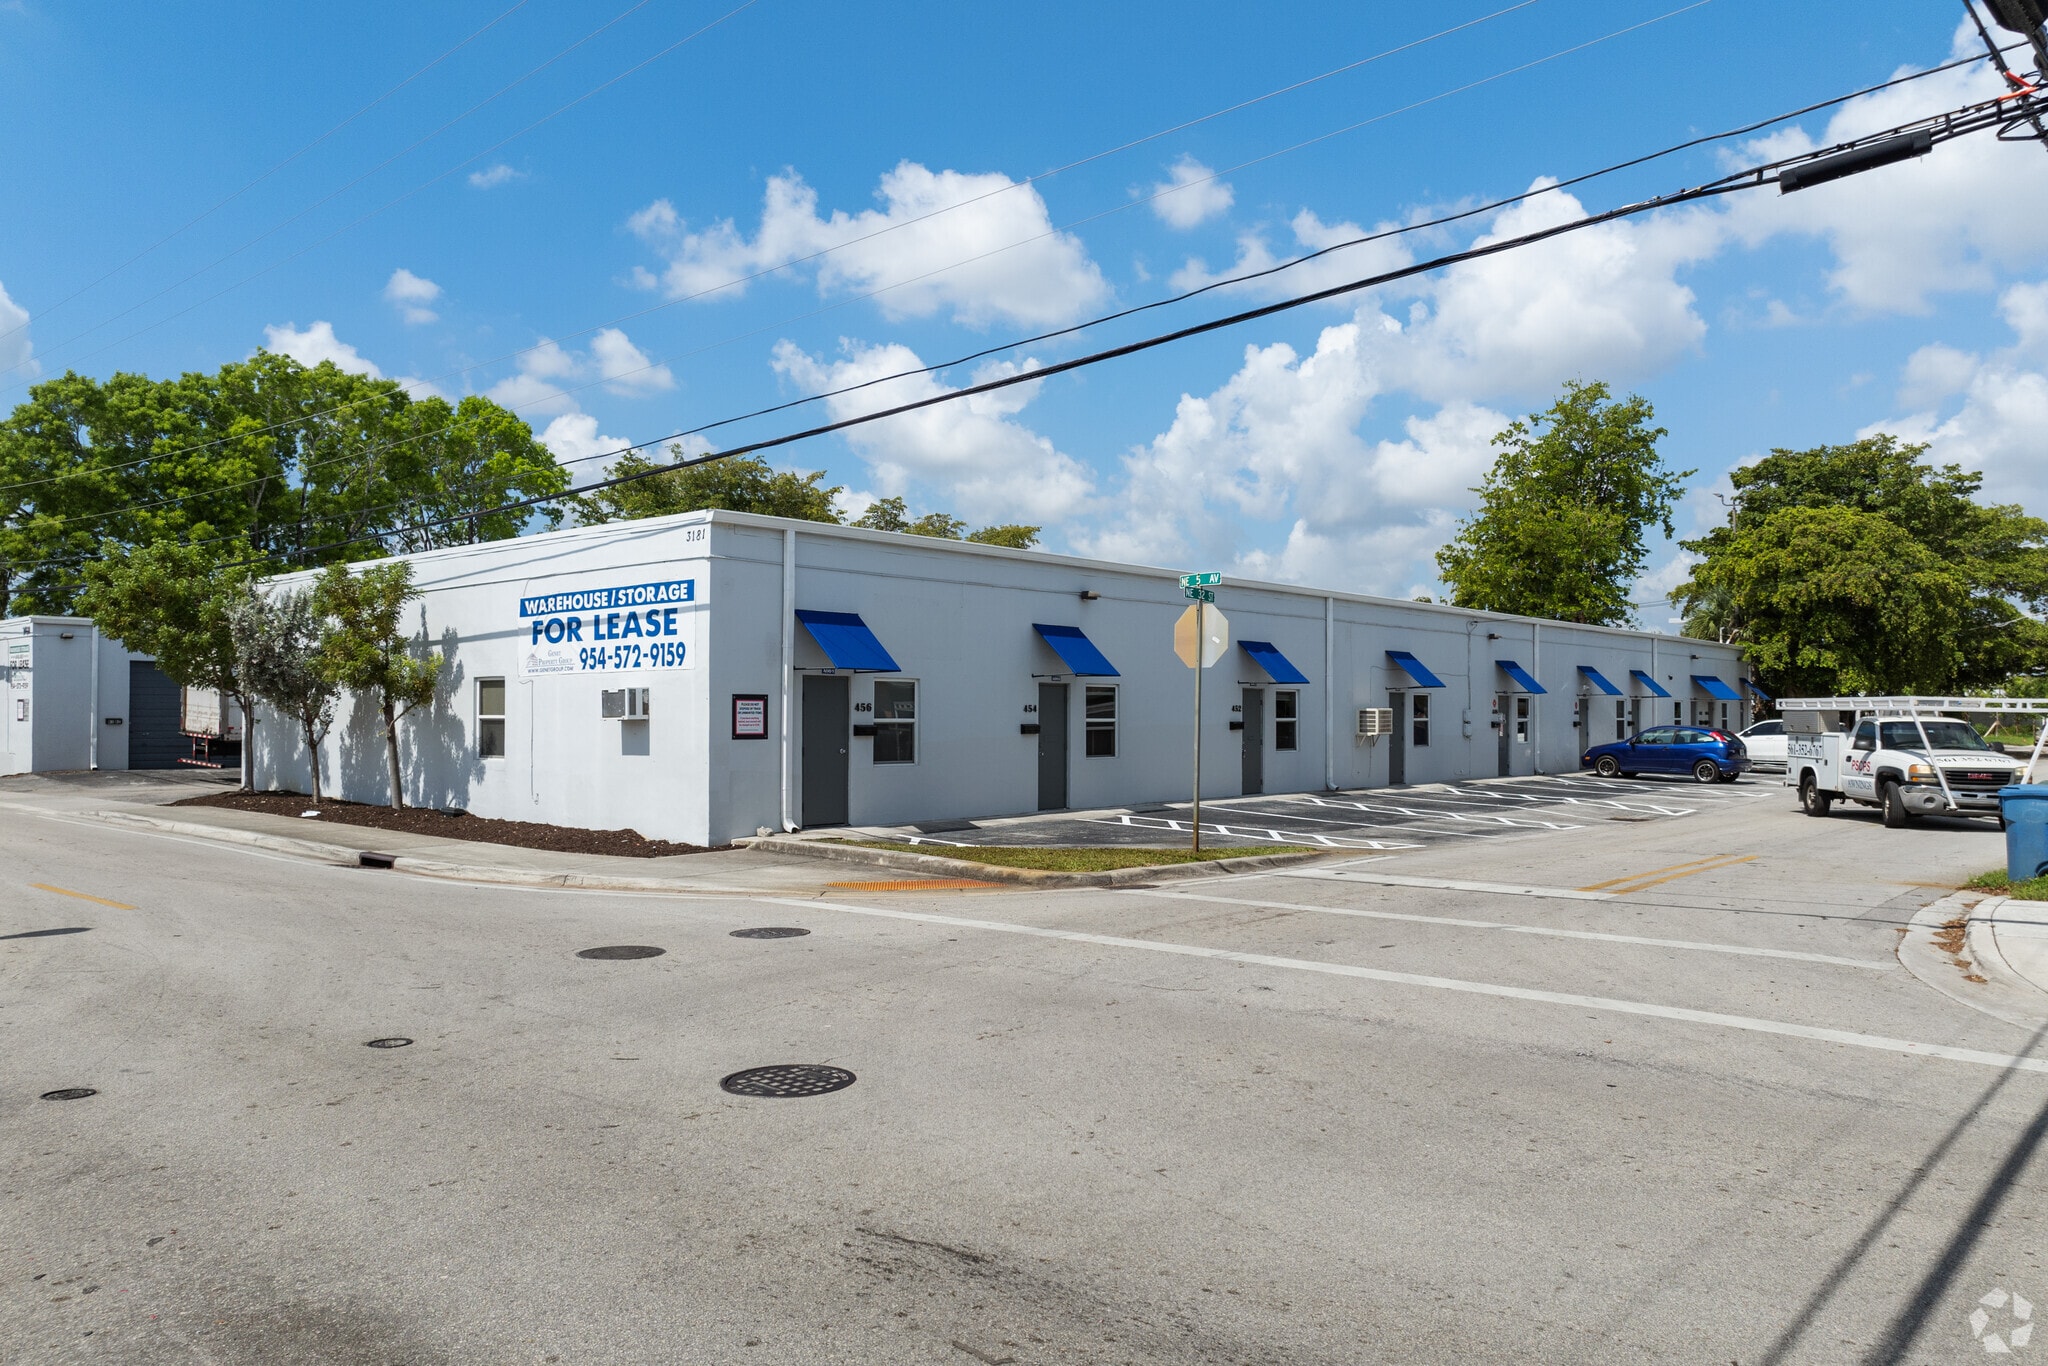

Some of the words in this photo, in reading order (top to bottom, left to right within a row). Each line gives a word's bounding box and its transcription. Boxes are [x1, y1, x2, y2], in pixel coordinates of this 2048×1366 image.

[686, 528, 706, 542] 3181
[1181, 577, 1190, 587] NE
[1196, 576, 1201, 585] 5
[1209, 573, 1219, 583] AV
[1185, 588, 1194, 598] NE
[1198, 590, 1205, 599] 32
[532, 616, 583, 645] FOR
[594, 608, 678, 640] LEASE
[579, 641, 686, 670] 954-572-9159
[855, 703, 872, 712] 456
[1023, 705, 1037, 713] 454
